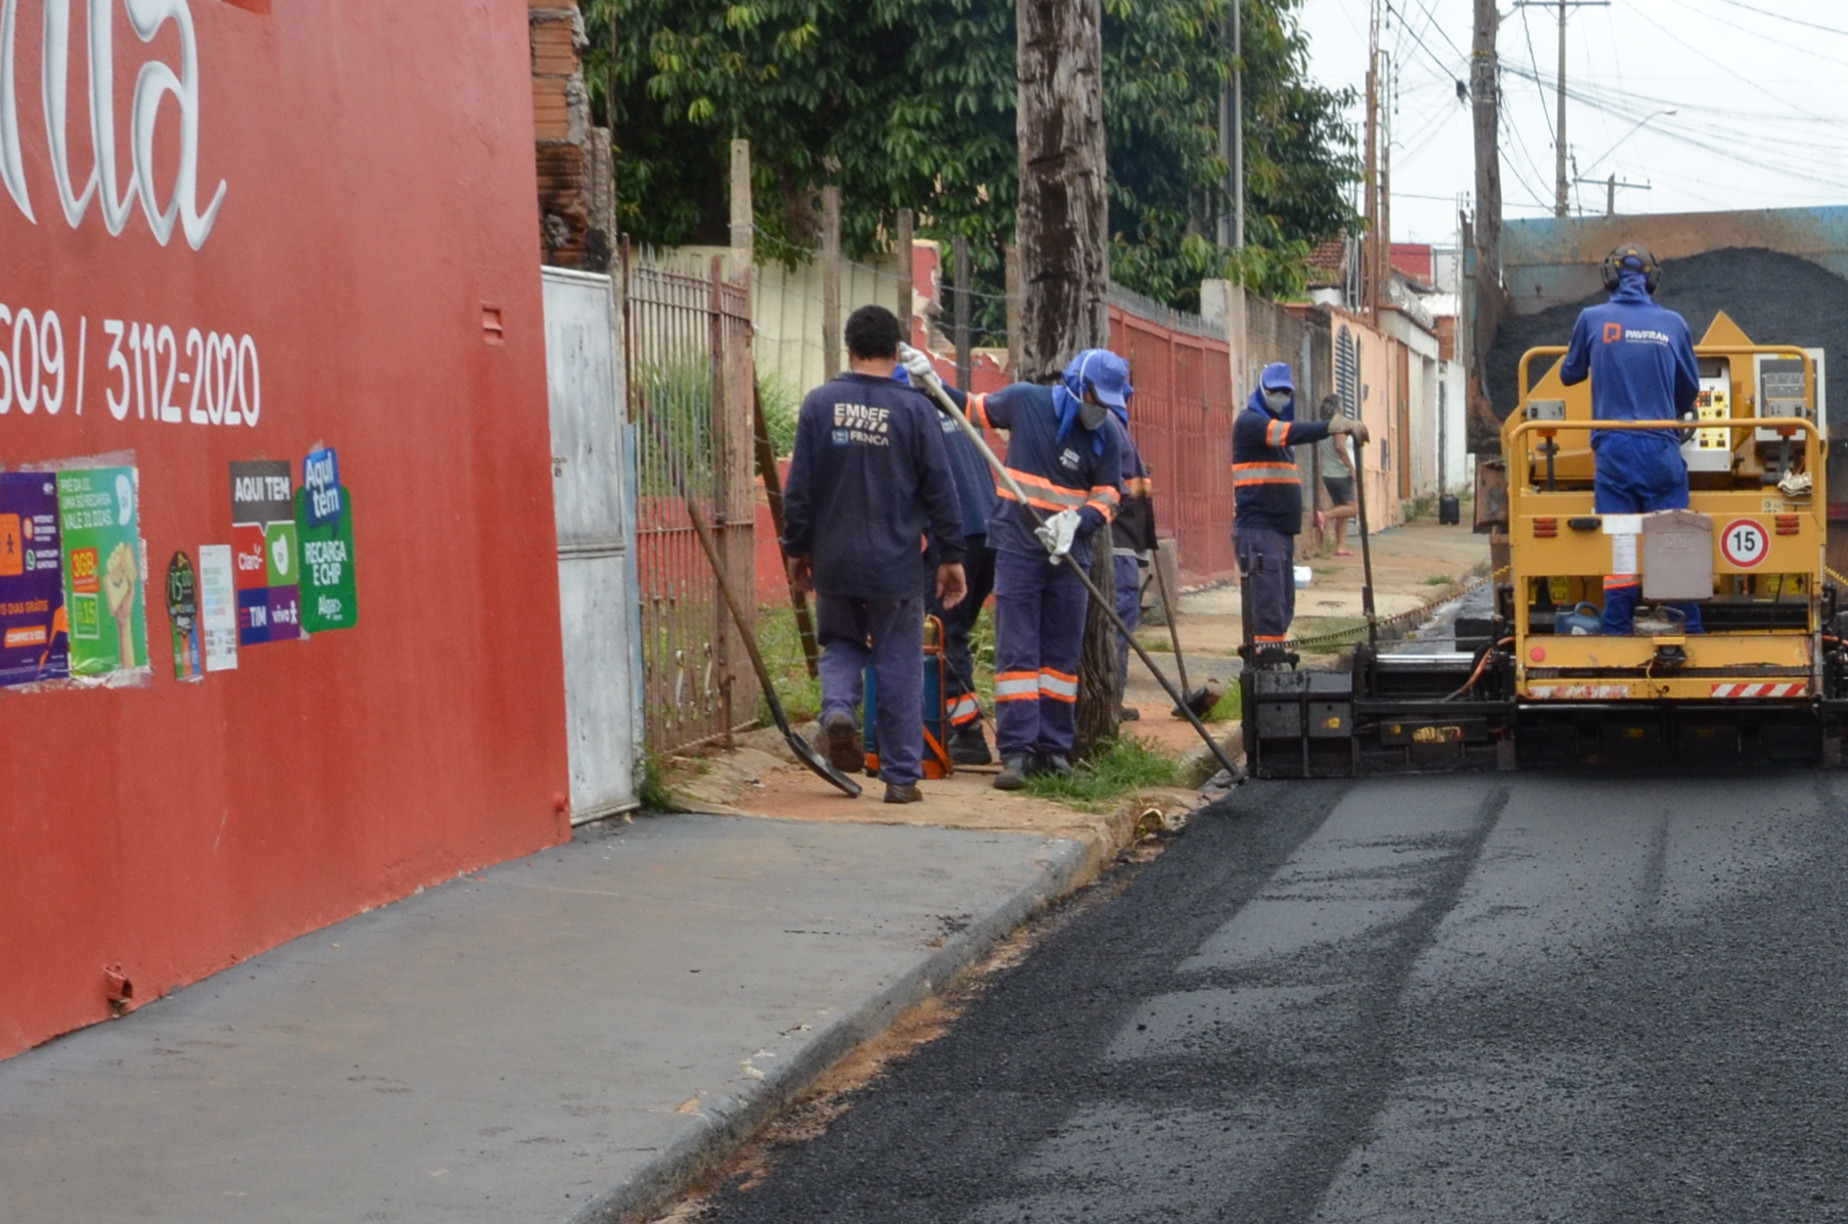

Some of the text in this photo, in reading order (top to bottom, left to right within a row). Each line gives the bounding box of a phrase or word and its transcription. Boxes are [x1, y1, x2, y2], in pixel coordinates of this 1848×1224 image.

[1625, 329, 1669, 343] PAVFRAN
[103, 318, 261, 428] 3112-2020
[834, 402, 890, 422] EMDEF
[305, 451, 334, 493] Aqui
[234, 476, 290, 503] AQUI TEM
[312, 486, 340, 519] tem
[1733, 530, 1756, 552] 15
[237, 552, 260, 571] Claro
[304, 540, 347, 566] RECARGA
[312, 562, 342, 587] E CHIP
[250, 606, 268, 628] TIM
[272, 605, 290, 624] vivo
